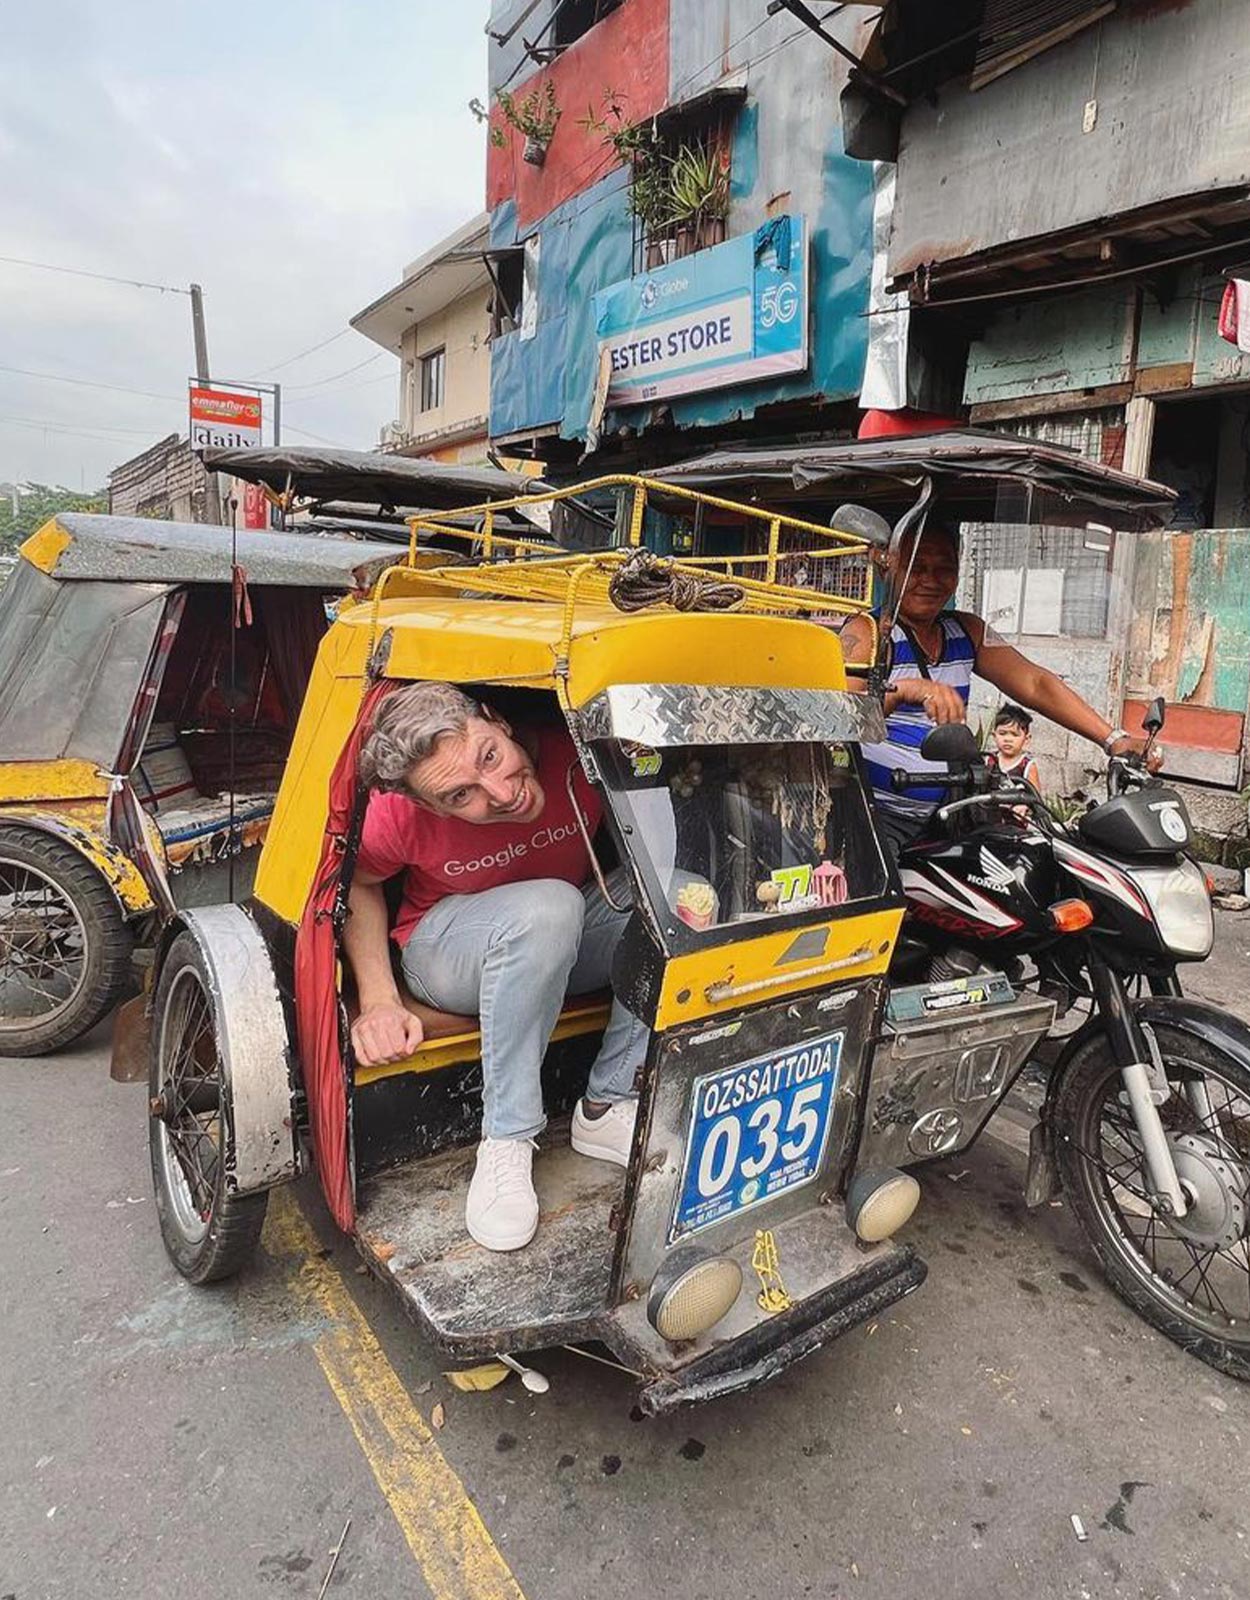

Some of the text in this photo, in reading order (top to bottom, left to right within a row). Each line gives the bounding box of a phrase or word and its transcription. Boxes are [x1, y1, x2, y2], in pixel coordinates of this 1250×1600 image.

[760, 281, 799, 328] 5G
[611, 316, 731, 372] ESTER STORE
[444, 842, 528, 877] Google
[771, 864, 813, 903] 77
[967, 874, 1011, 895] HONDA
[703, 1042, 832, 1118] OZSSATTODA
[698, 1082, 823, 1197] 035
